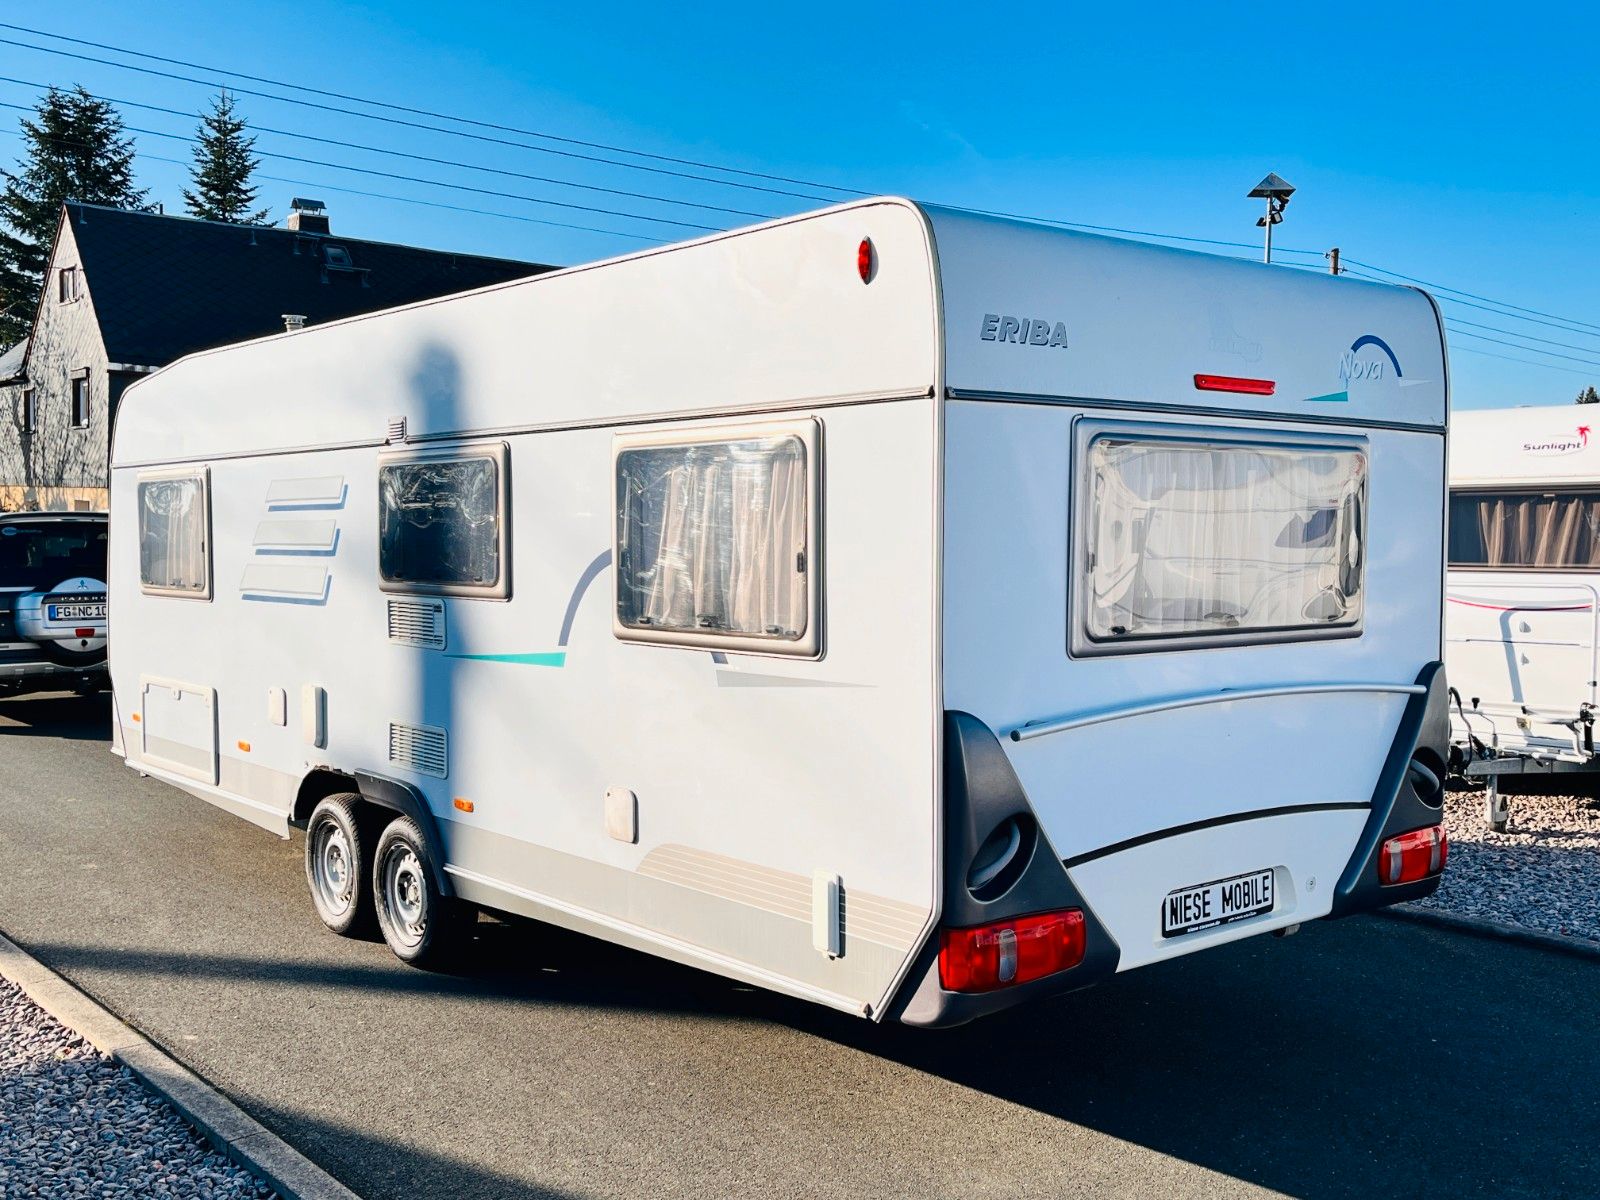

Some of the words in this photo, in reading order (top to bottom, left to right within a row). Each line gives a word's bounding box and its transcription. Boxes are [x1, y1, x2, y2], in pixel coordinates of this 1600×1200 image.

[980, 313, 1068, 348] ERIBA
[1338, 351, 1384, 380] Nova
[1523, 442, 1581, 451] Sunlight
[56, 606, 71, 617] FG
[78, 606, 93, 617] NC
[1170, 889, 1211, 927] NIESE
[1221, 874, 1270, 914] MOBILE
